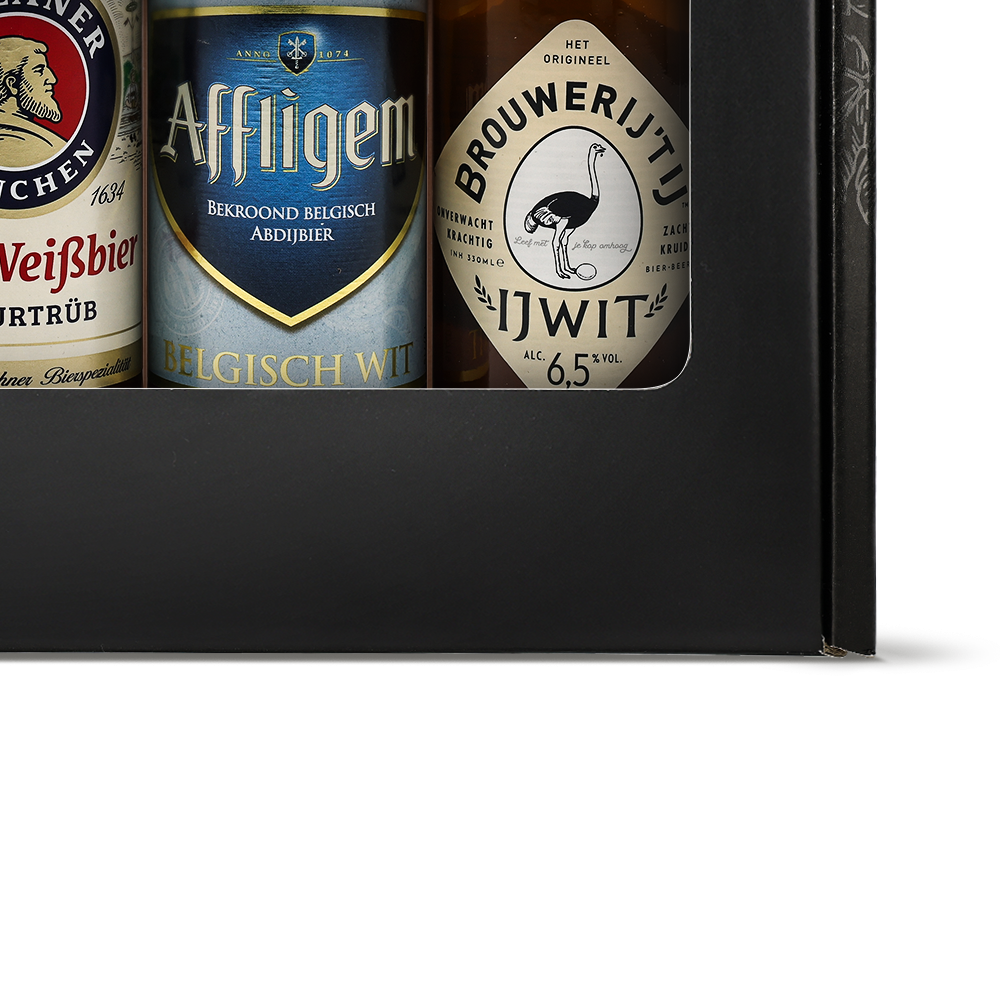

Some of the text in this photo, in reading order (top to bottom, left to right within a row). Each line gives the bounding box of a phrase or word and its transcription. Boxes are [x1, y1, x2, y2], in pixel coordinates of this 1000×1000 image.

[236, 50, 349, 58] ANNO 1074
[565, 40, 590, 49] HET
[543, 54, 610, 65] ORIGINEEL
[159, 81, 418, 191] Affligem
[90, 180, 125, 206] 1634
[207, 199, 376, 221] BEKROOND BELGISCH
[436, 205, 494, 231] ONVERWACHT
[250, 225, 335, 246] ABDIJBIER
[447, 228, 493, 249] KRACHTIG
[663, 222, 690, 236] ZACH
[498, 289, 650, 342] IJWIT
[39, 356, 132, 387] Bierspezialität
[163, 339, 343, 388] BELGISCH
[354, 342, 414, 383] WIT
[524, 350, 546, 361] ALC.
[547, 352, 590, 389] 6,5
[602, 354, 623, 363] VOL.
